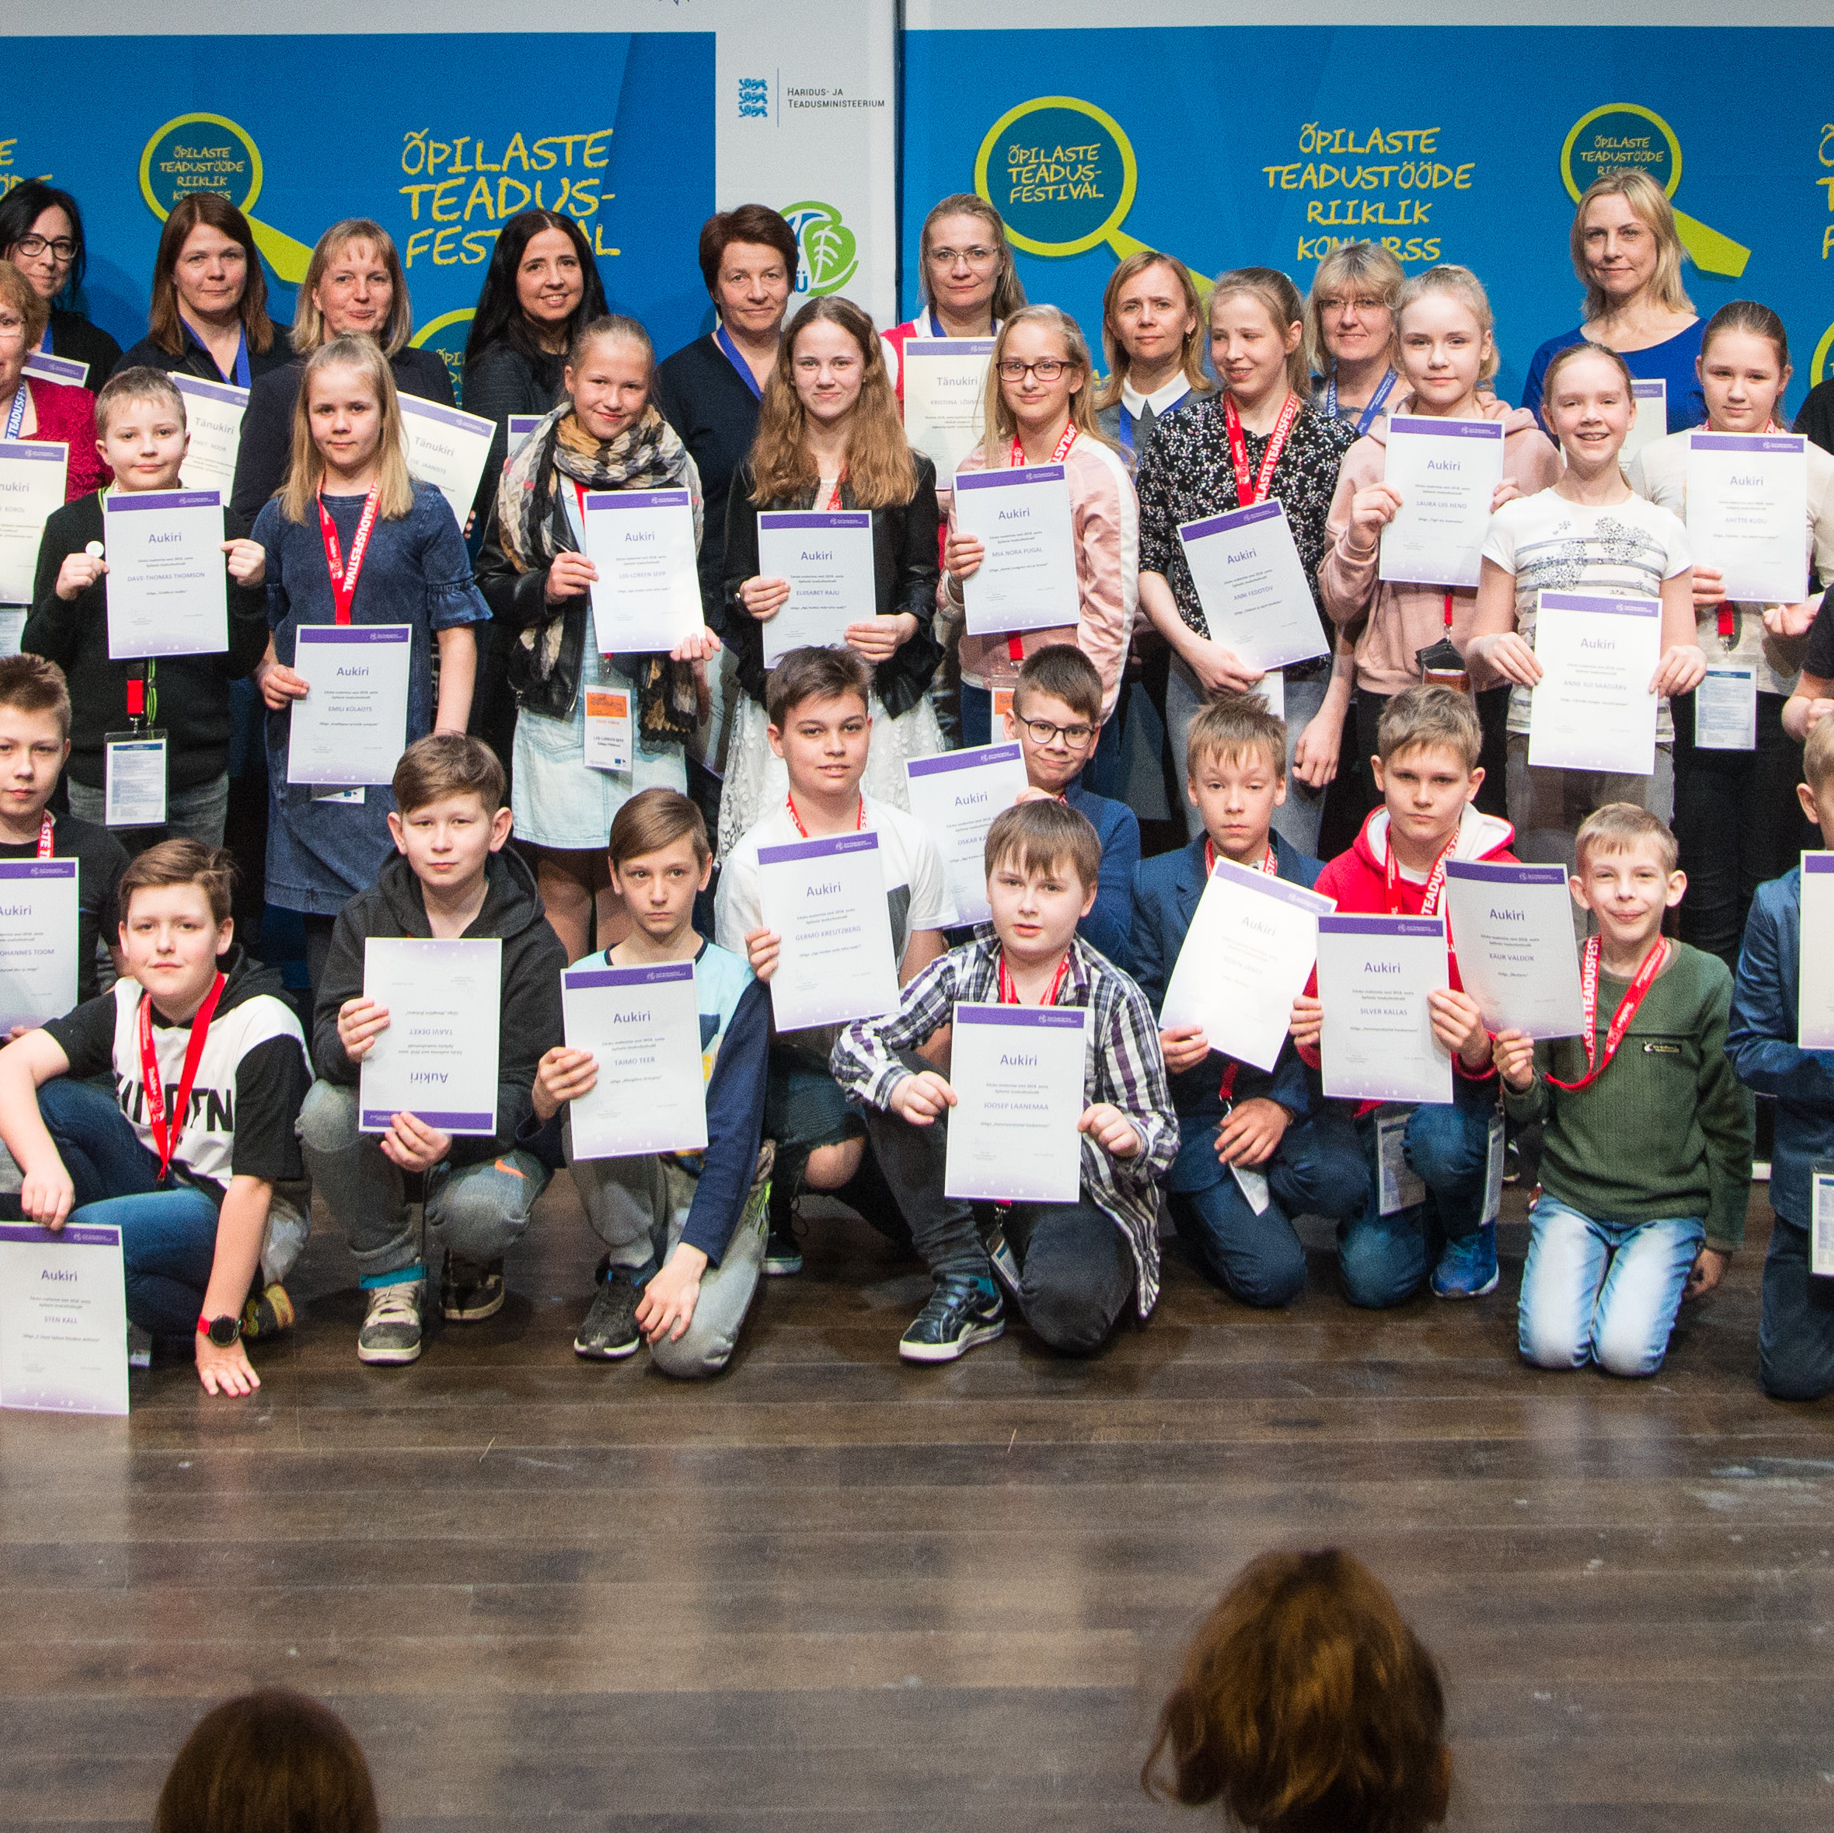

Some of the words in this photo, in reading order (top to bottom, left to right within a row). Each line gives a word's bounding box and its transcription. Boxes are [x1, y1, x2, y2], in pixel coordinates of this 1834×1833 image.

[1299, 122, 1441, 154] ÕPILASTE
[1594, 135, 1651, 148] ÕPILASTE
[173, 146, 231, 158] ÕPILASTE
[401, 128, 613, 175] ÕPILASTE
[1008, 143, 1101, 165] ÕPILASTE
[1580, 150, 1665, 163] TEADUSTÖÖDE
[159, 160, 245, 173] TEADUSTÖÖDE
[1008, 164, 1102, 185] TEADUS-
[1262, 161, 1476, 189] TEADUSTÖÖDE
[177, 176, 227, 187] RIIKLIK
[1009, 180, 1105, 203] FESTIVAL
[398, 176, 615, 221] TEADUS-
[1307, 199, 1432, 225] RIIKLIK
[937, 376, 979, 388] Tänukiri
[194, 416, 235, 436] Tänukiri
[414, 436, 455, 458] Tänukiri
[1427, 460, 1460, 471] Aukiri
[1730, 476, 1763, 485] Aukiri
[999, 508, 1030, 519] Aukiri
[149, 533, 182, 543] Aukiri
[625, 532, 655, 541] Aukiri
[342, 501, 375, 593] TEADUSFESTIVAL
[801, 551, 832, 560] Aukiri
[1228, 549, 1256, 564] Aukiri
[1580, 638, 1615, 649] Aukiri
[337, 667, 369, 676] Aukiri
[955, 792, 988, 806] Aukiri
[807, 882, 841, 897] Aukiri
[1490, 909, 1524, 920] Aukiri
[1241, 916, 1275, 936] Aukiri
[1364, 962, 1400, 973] Aukiri
[614, 1011, 650, 1023] Aukiri
[1000, 1054, 1037, 1066] Aukiri
[410, 1073, 448, 1083] Aukiri
[41, 1270, 77, 1281] Aukiri
